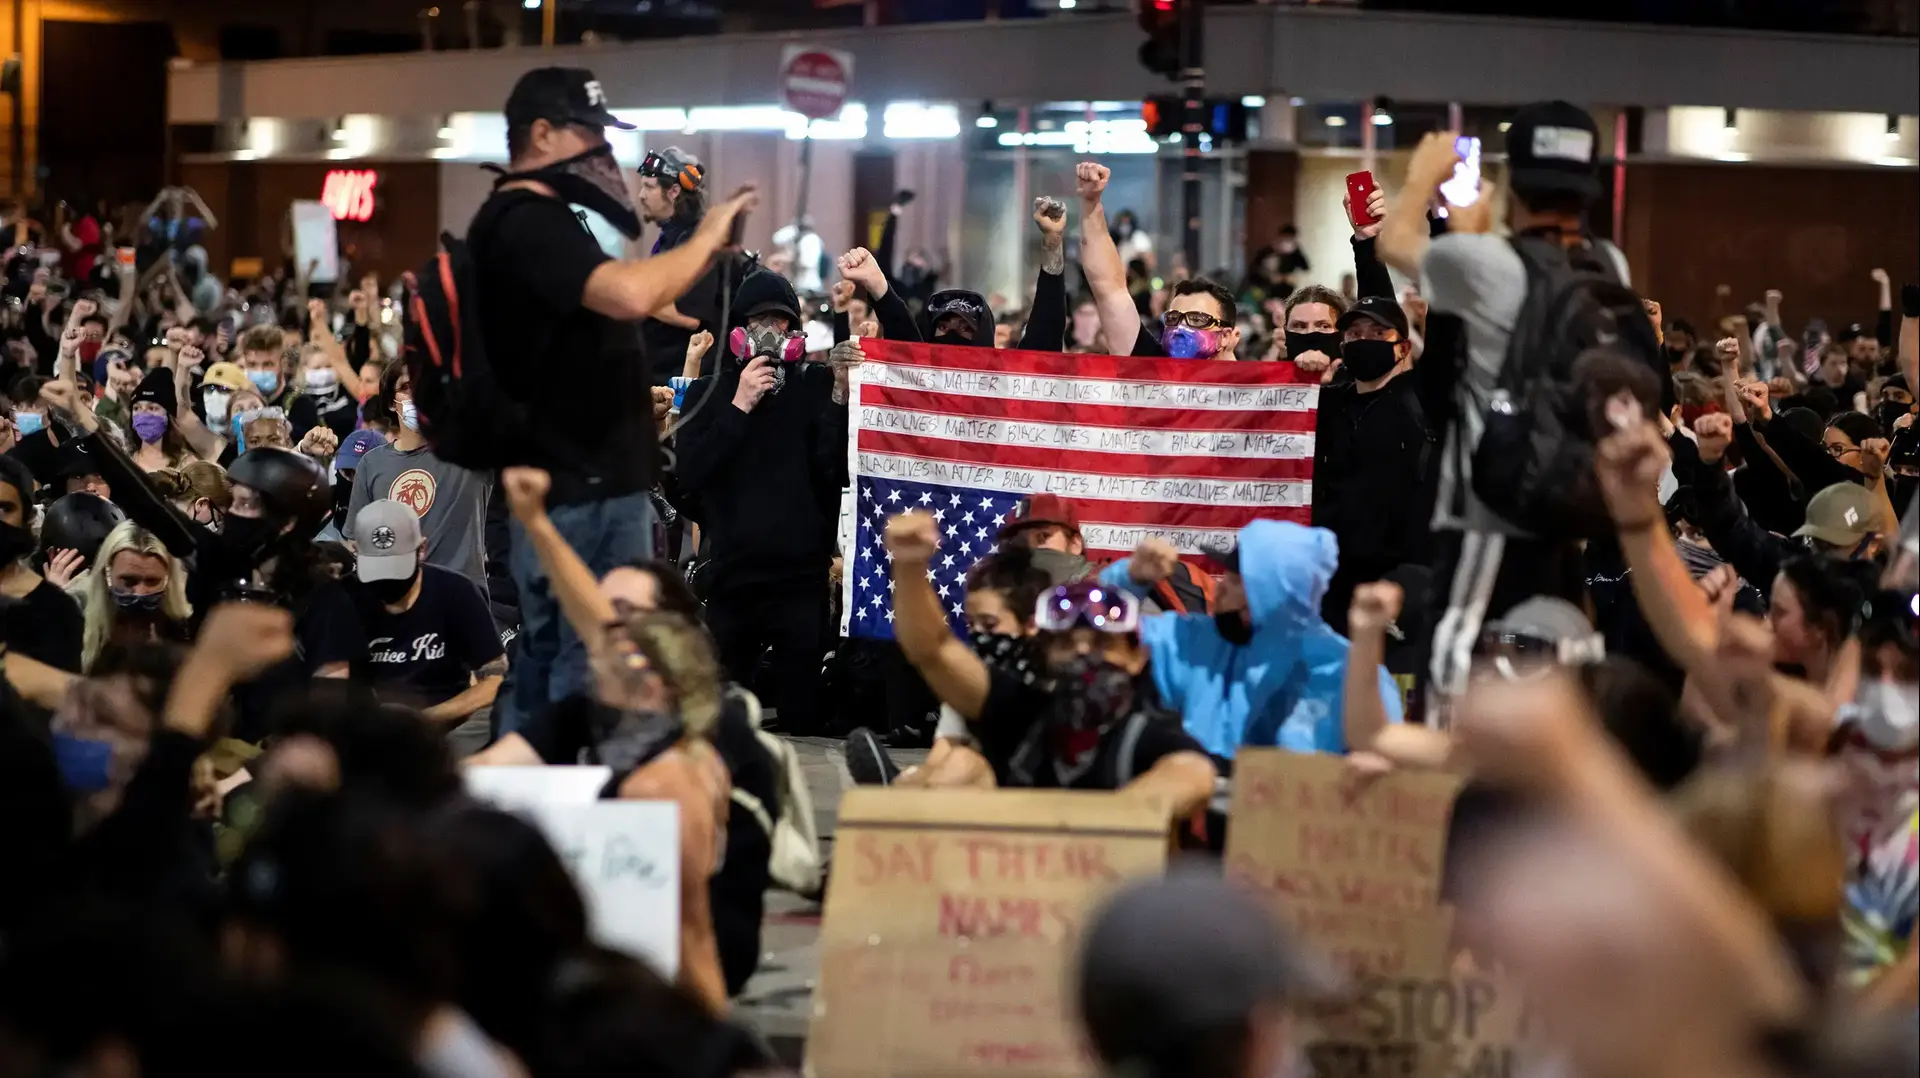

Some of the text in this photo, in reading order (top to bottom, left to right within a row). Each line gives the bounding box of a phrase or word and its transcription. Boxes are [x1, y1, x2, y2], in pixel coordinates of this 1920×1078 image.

[899, 368, 936, 390] LIVES
[1012, 377, 1058, 397] BLACK
[1065, 381, 1101, 399] LIVES
[1110, 384, 1170, 401] MATTER
[1217, 389, 1253, 407] LIVES
[862, 408, 899, 428] BLACK
[902, 413, 938, 432] LIVES
[945, 418, 997, 440] MATTER
[1053, 427, 1090, 446] LIVES
[858, 454, 896, 473] BLACK
[897, 457, 930, 477] LIVES
[1046, 473, 1090, 494] LIVES
[1096, 476, 1158, 495] MATTER
[1233, 483, 1290, 503] MATTER
[410, 632, 446, 661] Kid
[854, 834, 940, 887] SAY
[1358, 976, 1497, 1041] STOP
